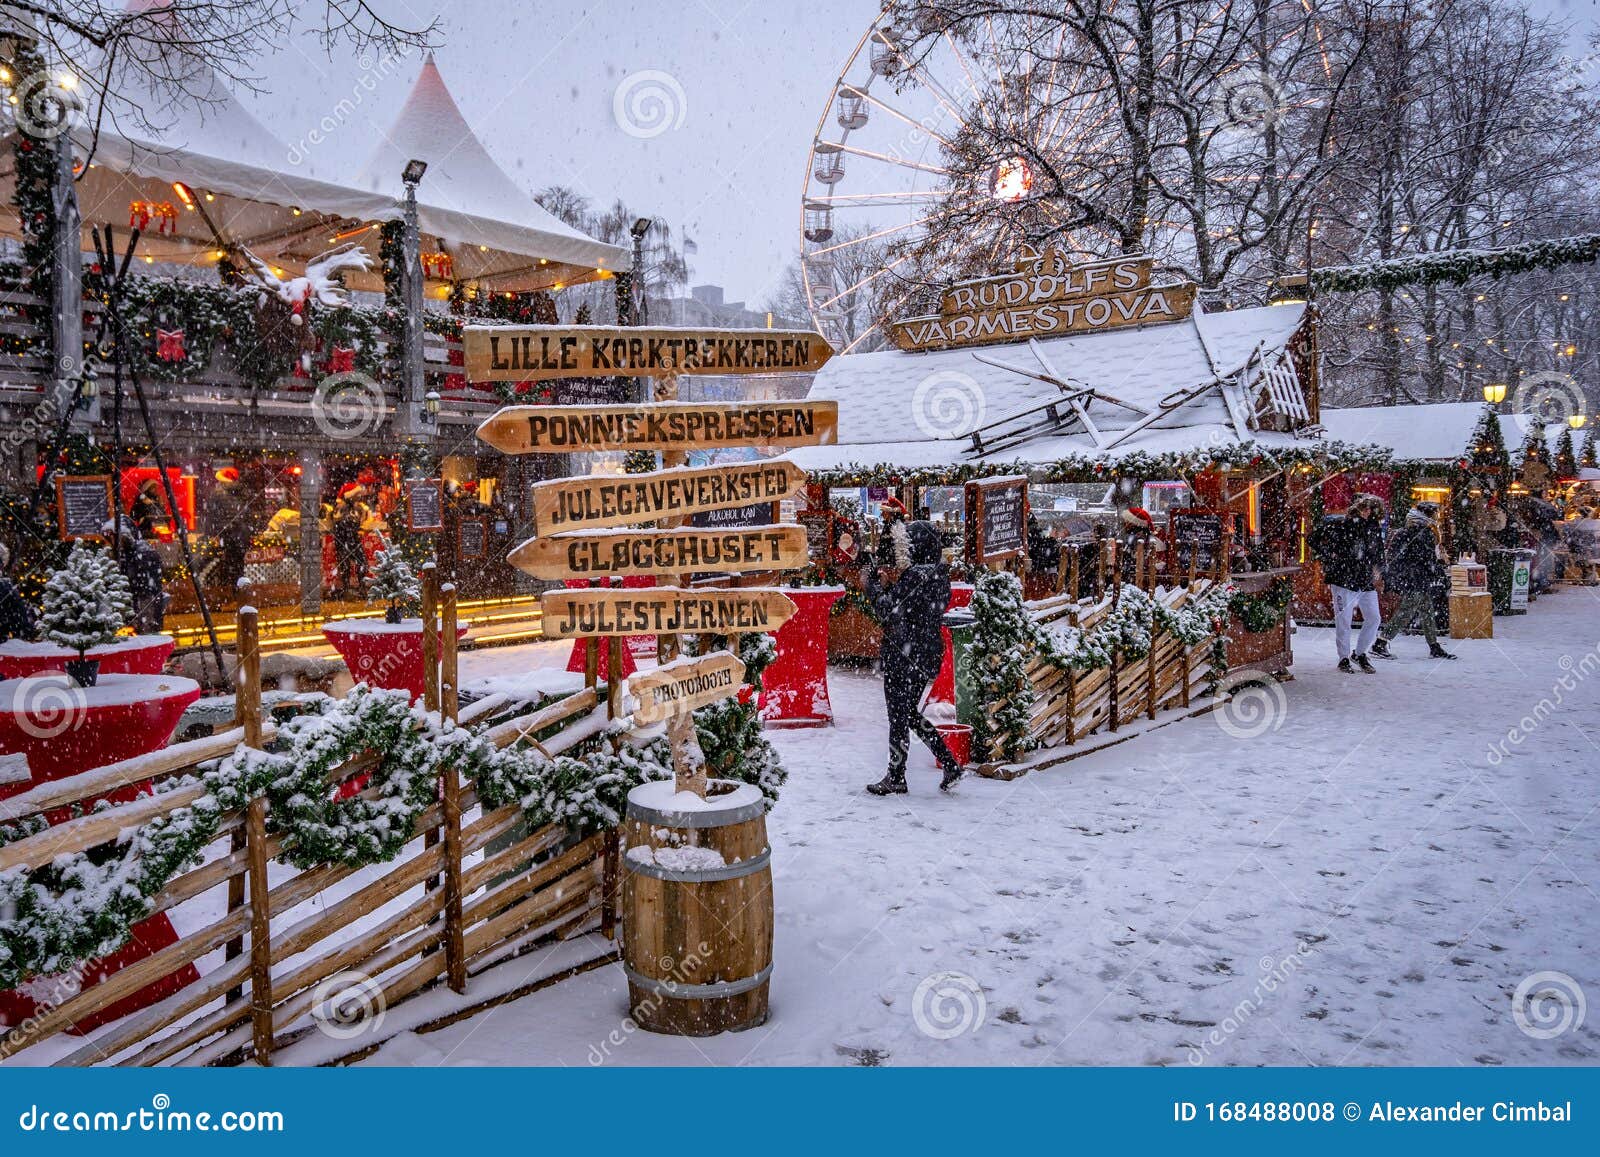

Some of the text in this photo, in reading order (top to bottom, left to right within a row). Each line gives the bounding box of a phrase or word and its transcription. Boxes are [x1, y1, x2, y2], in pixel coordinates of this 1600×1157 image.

[952, 262, 1139, 310] RUDOLFS
[903, 291, 1174, 346] VARMESTOVA
[489, 336, 809, 371] LILLE KORKTREKKEREN
[529, 408, 814, 446] PONNIEKSPRESSEN
[552, 468, 787, 524] JULEGAVEVERKSTED
[741, 507, 756, 521] KAN
[568, 532, 785, 572] GLØGGHUSET
[560, 600, 768, 634] JULESTJERNEN
[652, 668, 732, 704] PHOTOBOOTH
